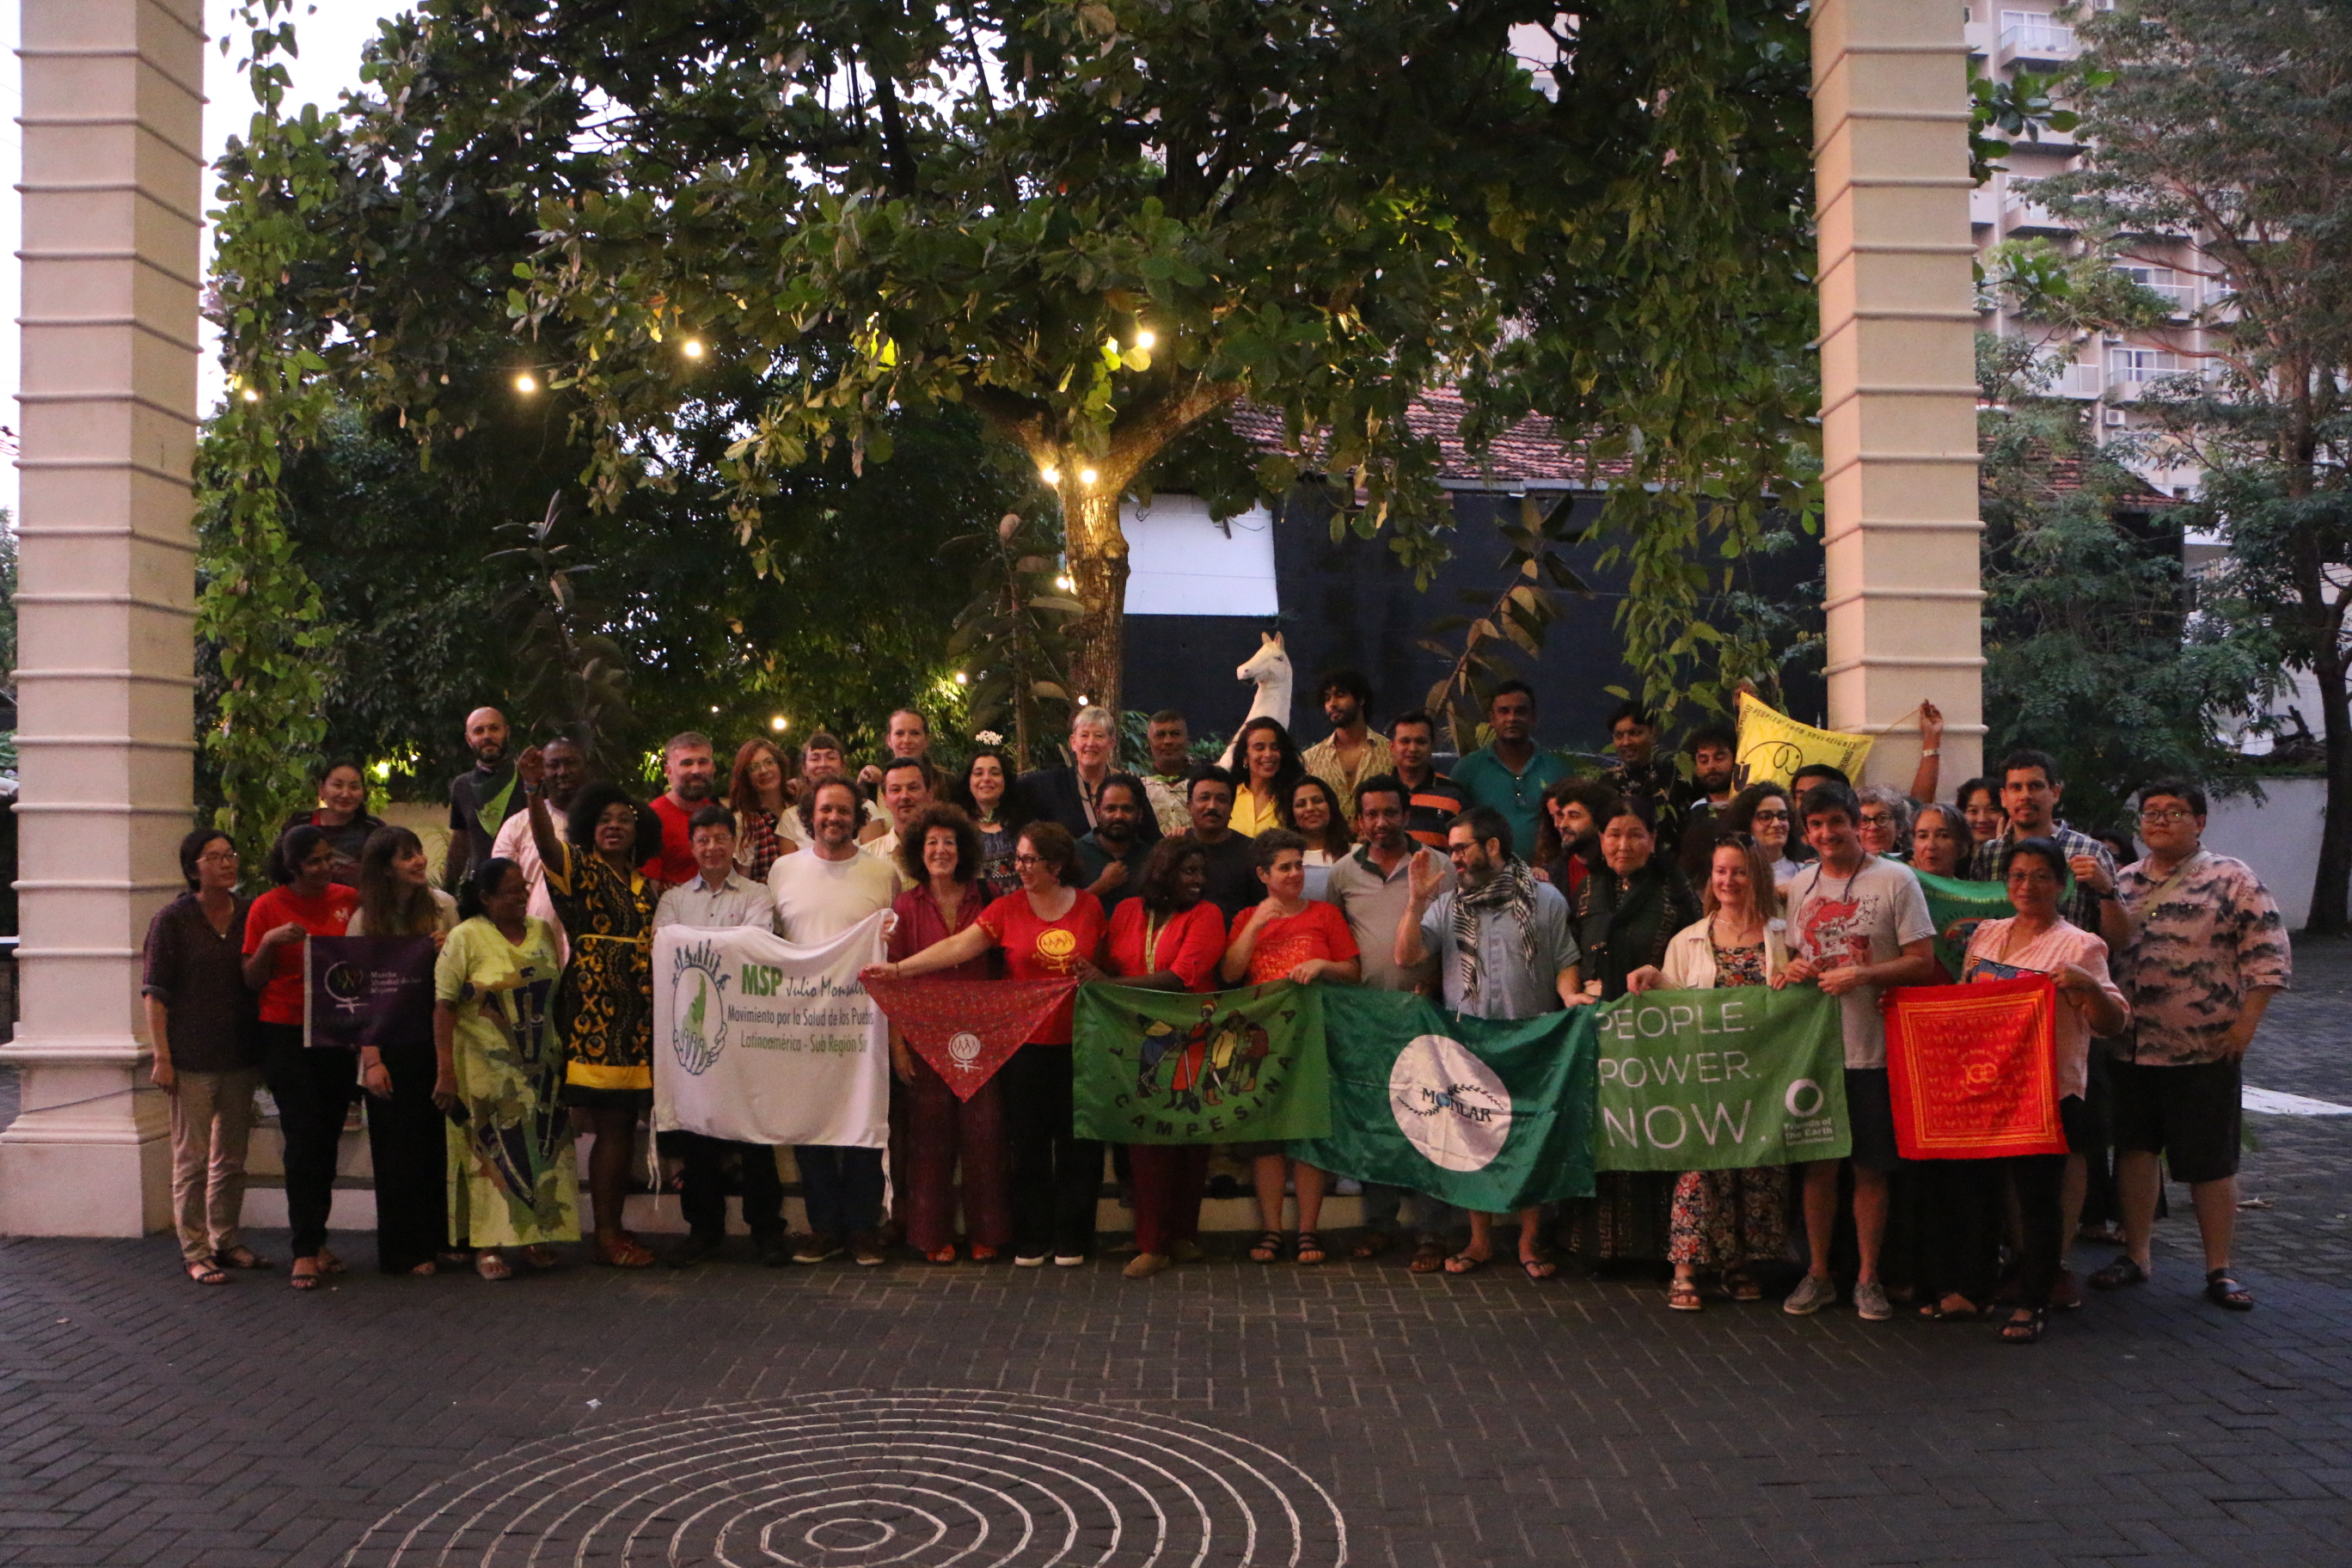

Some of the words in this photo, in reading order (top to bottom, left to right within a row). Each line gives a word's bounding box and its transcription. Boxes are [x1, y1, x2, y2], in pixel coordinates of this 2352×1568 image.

[741, 964, 783, 996] MSP
[787, 976, 818, 997] Julio
[727, 1004, 775, 1025] Movimiento
[777, 1011, 790, 1028] por
[793, 1008, 801, 1026] la
[803, 1008, 826, 1026] Salud
[828, 1008, 838, 1026] de
[839, 1007, 850, 1026] los
[740, 1029, 801, 1051] Latinoamérica
[810, 1034, 826, 1053] Sub
[828, 1032, 856, 1057] Región
[1114, 1057, 1294, 1136] CAMPESINA
[1804, 1127, 1833, 1136] Earth
[1822, 1117, 1832, 1125] of
